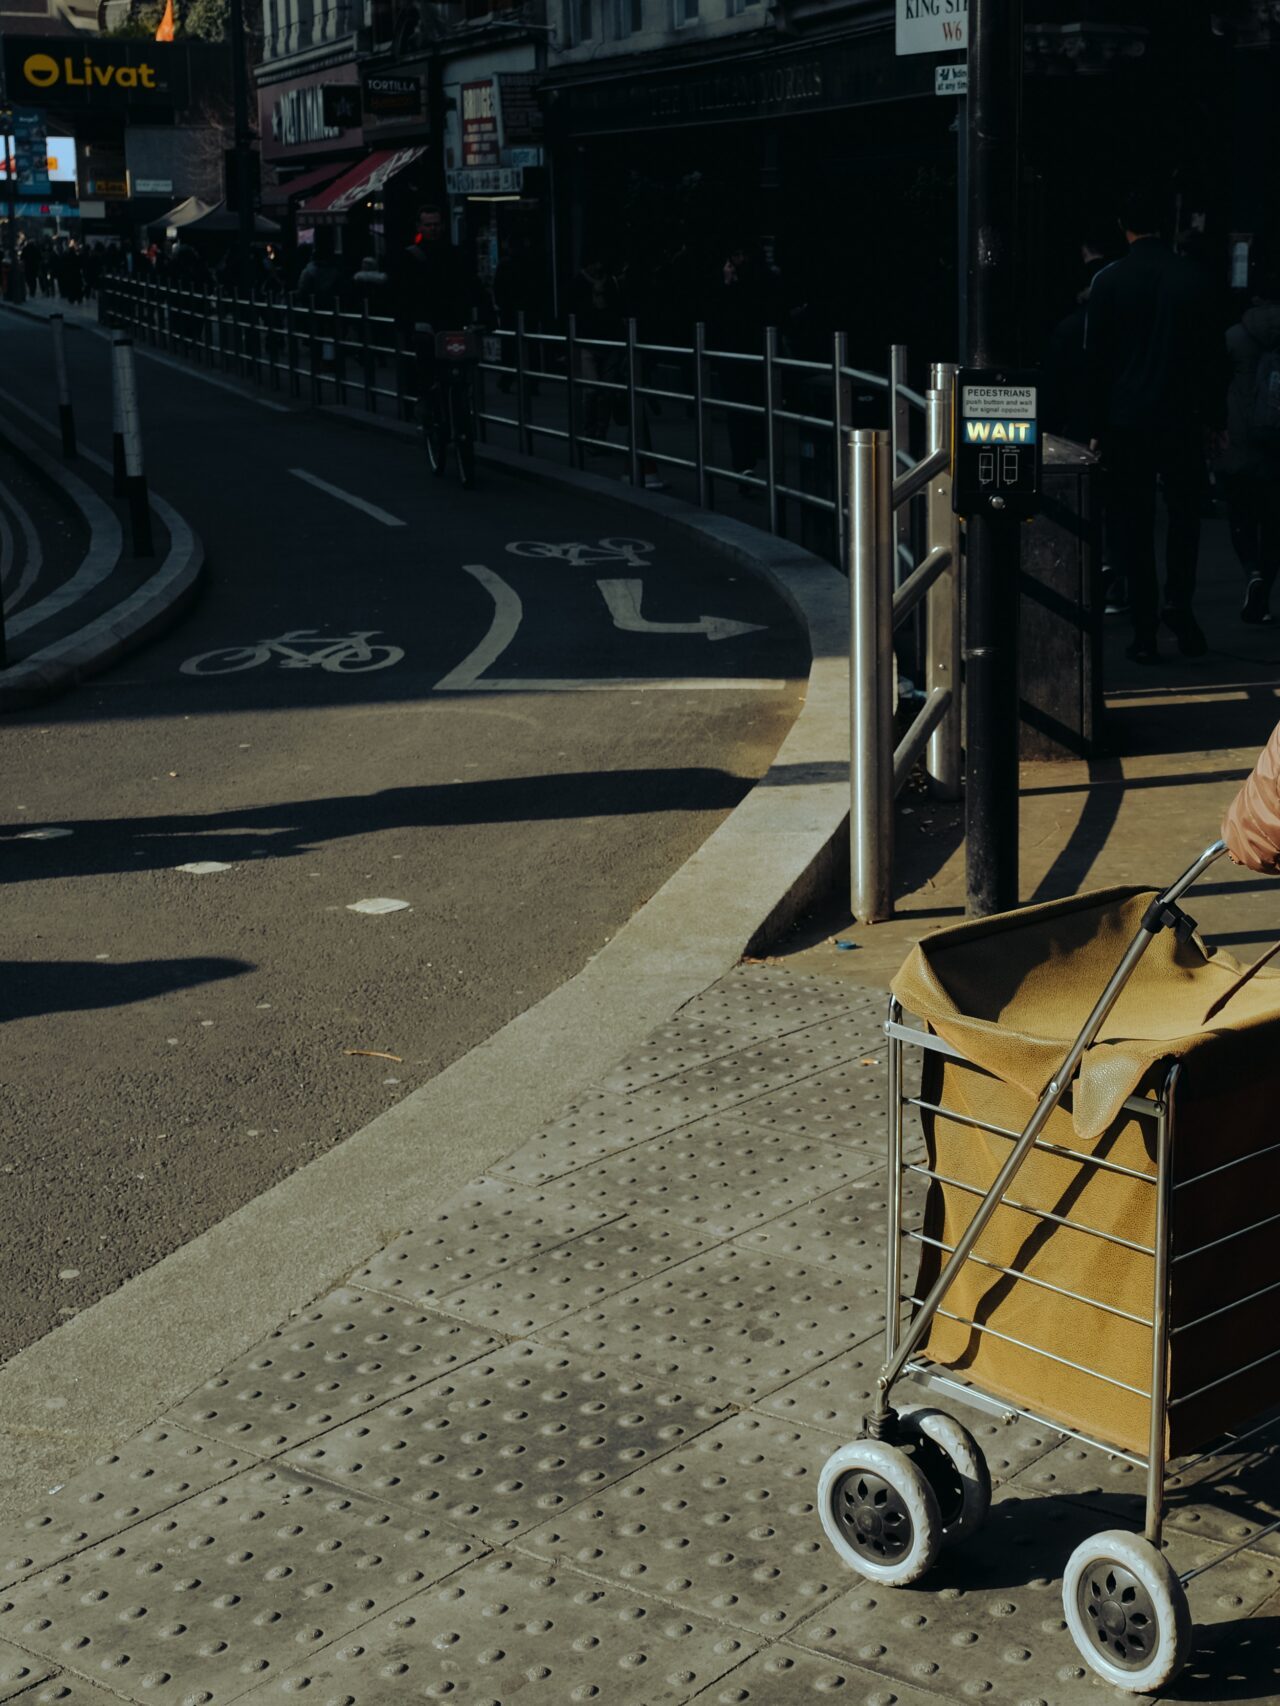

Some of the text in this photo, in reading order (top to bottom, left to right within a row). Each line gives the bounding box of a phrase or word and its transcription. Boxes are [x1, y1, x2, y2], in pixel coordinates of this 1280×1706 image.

[906, 0, 939, 19] KING
[943, 22, 962, 41] W6
[64, 56, 157, 89] Livat
[368, 79, 416, 91] TORTILLA
[967, 388, 1031, 397] PEDESTRIANS
[966, 422, 1031, 442] WAIT
